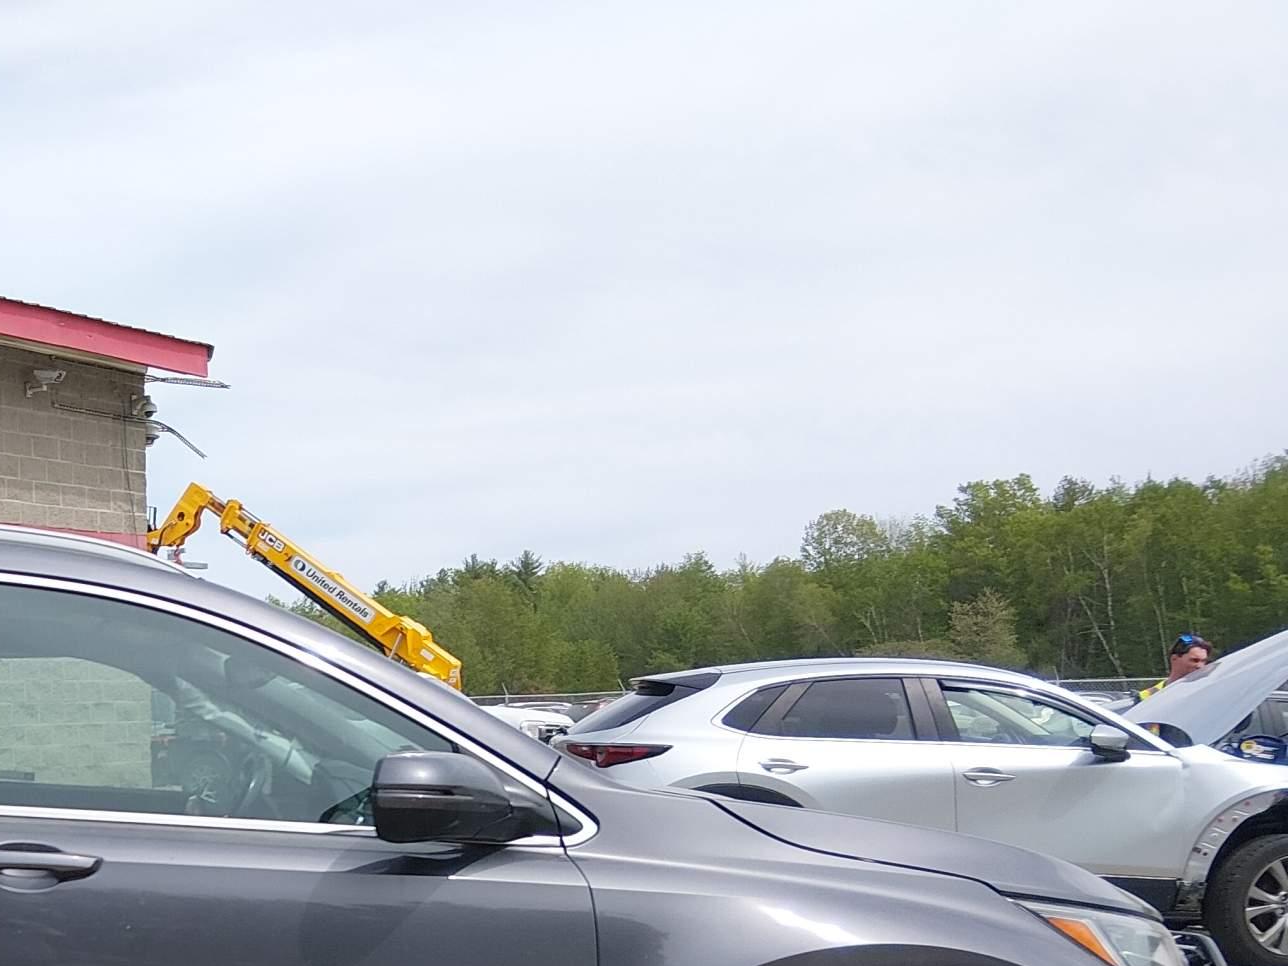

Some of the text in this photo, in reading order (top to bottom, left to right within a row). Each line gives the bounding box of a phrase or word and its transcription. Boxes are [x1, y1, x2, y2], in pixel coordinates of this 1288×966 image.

[258, 530, 285, 552] JCB
[305, 567, 370, 619] United Rentals
